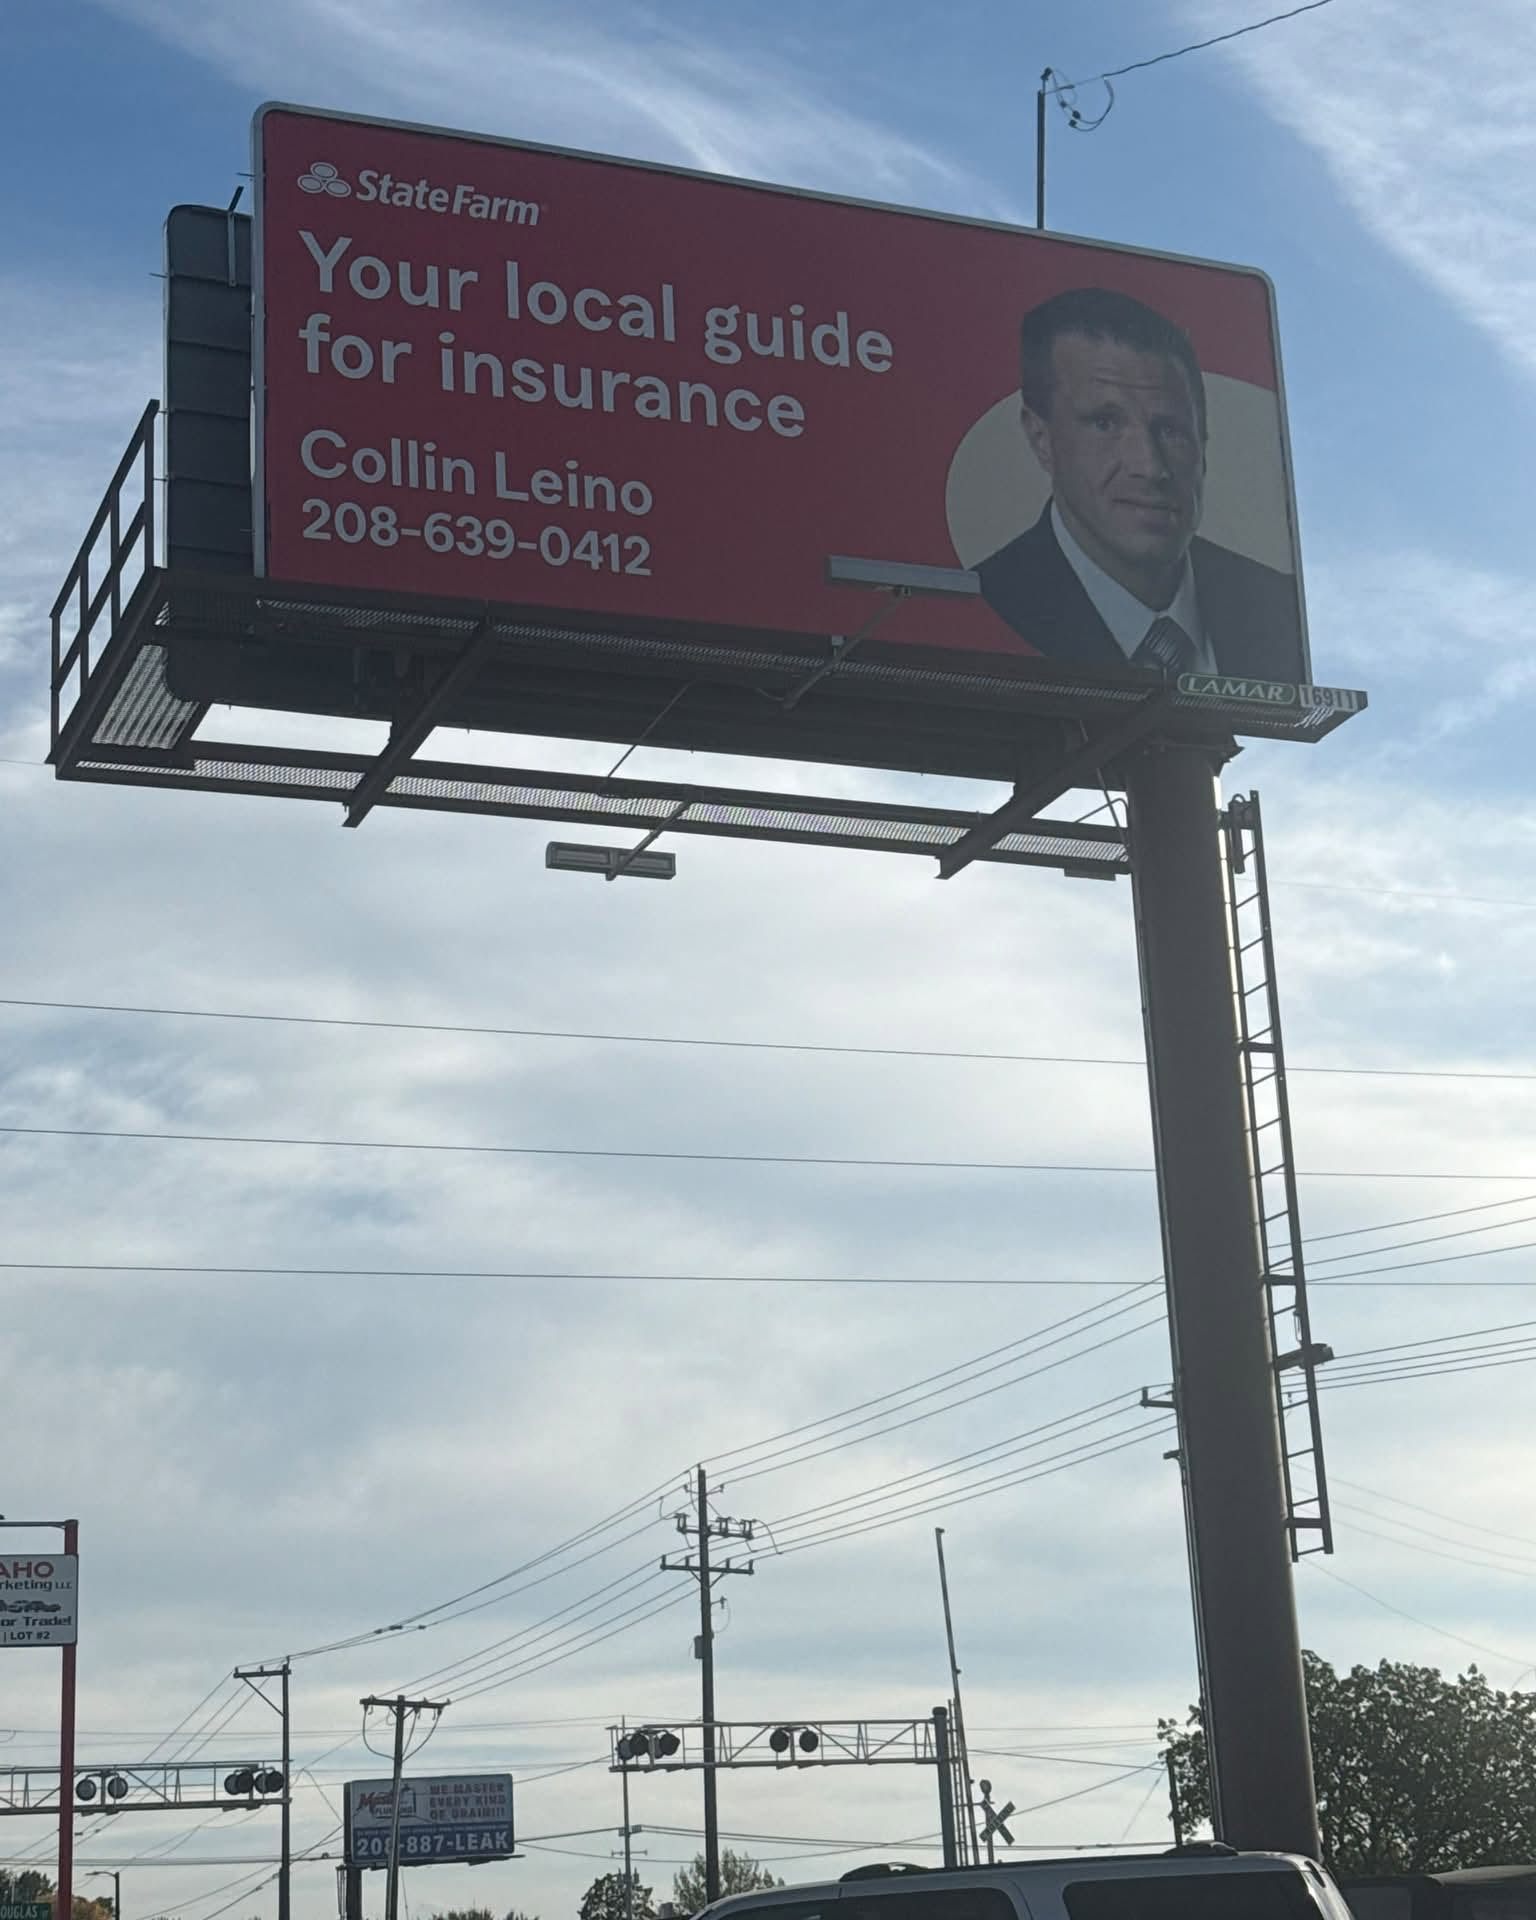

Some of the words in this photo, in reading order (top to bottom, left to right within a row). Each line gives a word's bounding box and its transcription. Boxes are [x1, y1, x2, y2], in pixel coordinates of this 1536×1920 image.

[299, 230, 478, 311] Your
[506, 261, 676, 342] local
[704, 304, 894, 373] guide
[299, 313, 412, 384] for
[440, 332, 805, 437] insurance
[300, 429, 476, 495] Collin
[495, 451, 653, 516] Leino
[302, 499, 652, 576] 208-639-0412
[1187, 677, 1284, 700] LAMAR
[10, 1631, 33, 1640] LOT
[0, 1904, 38, 1919] OUGLAS
